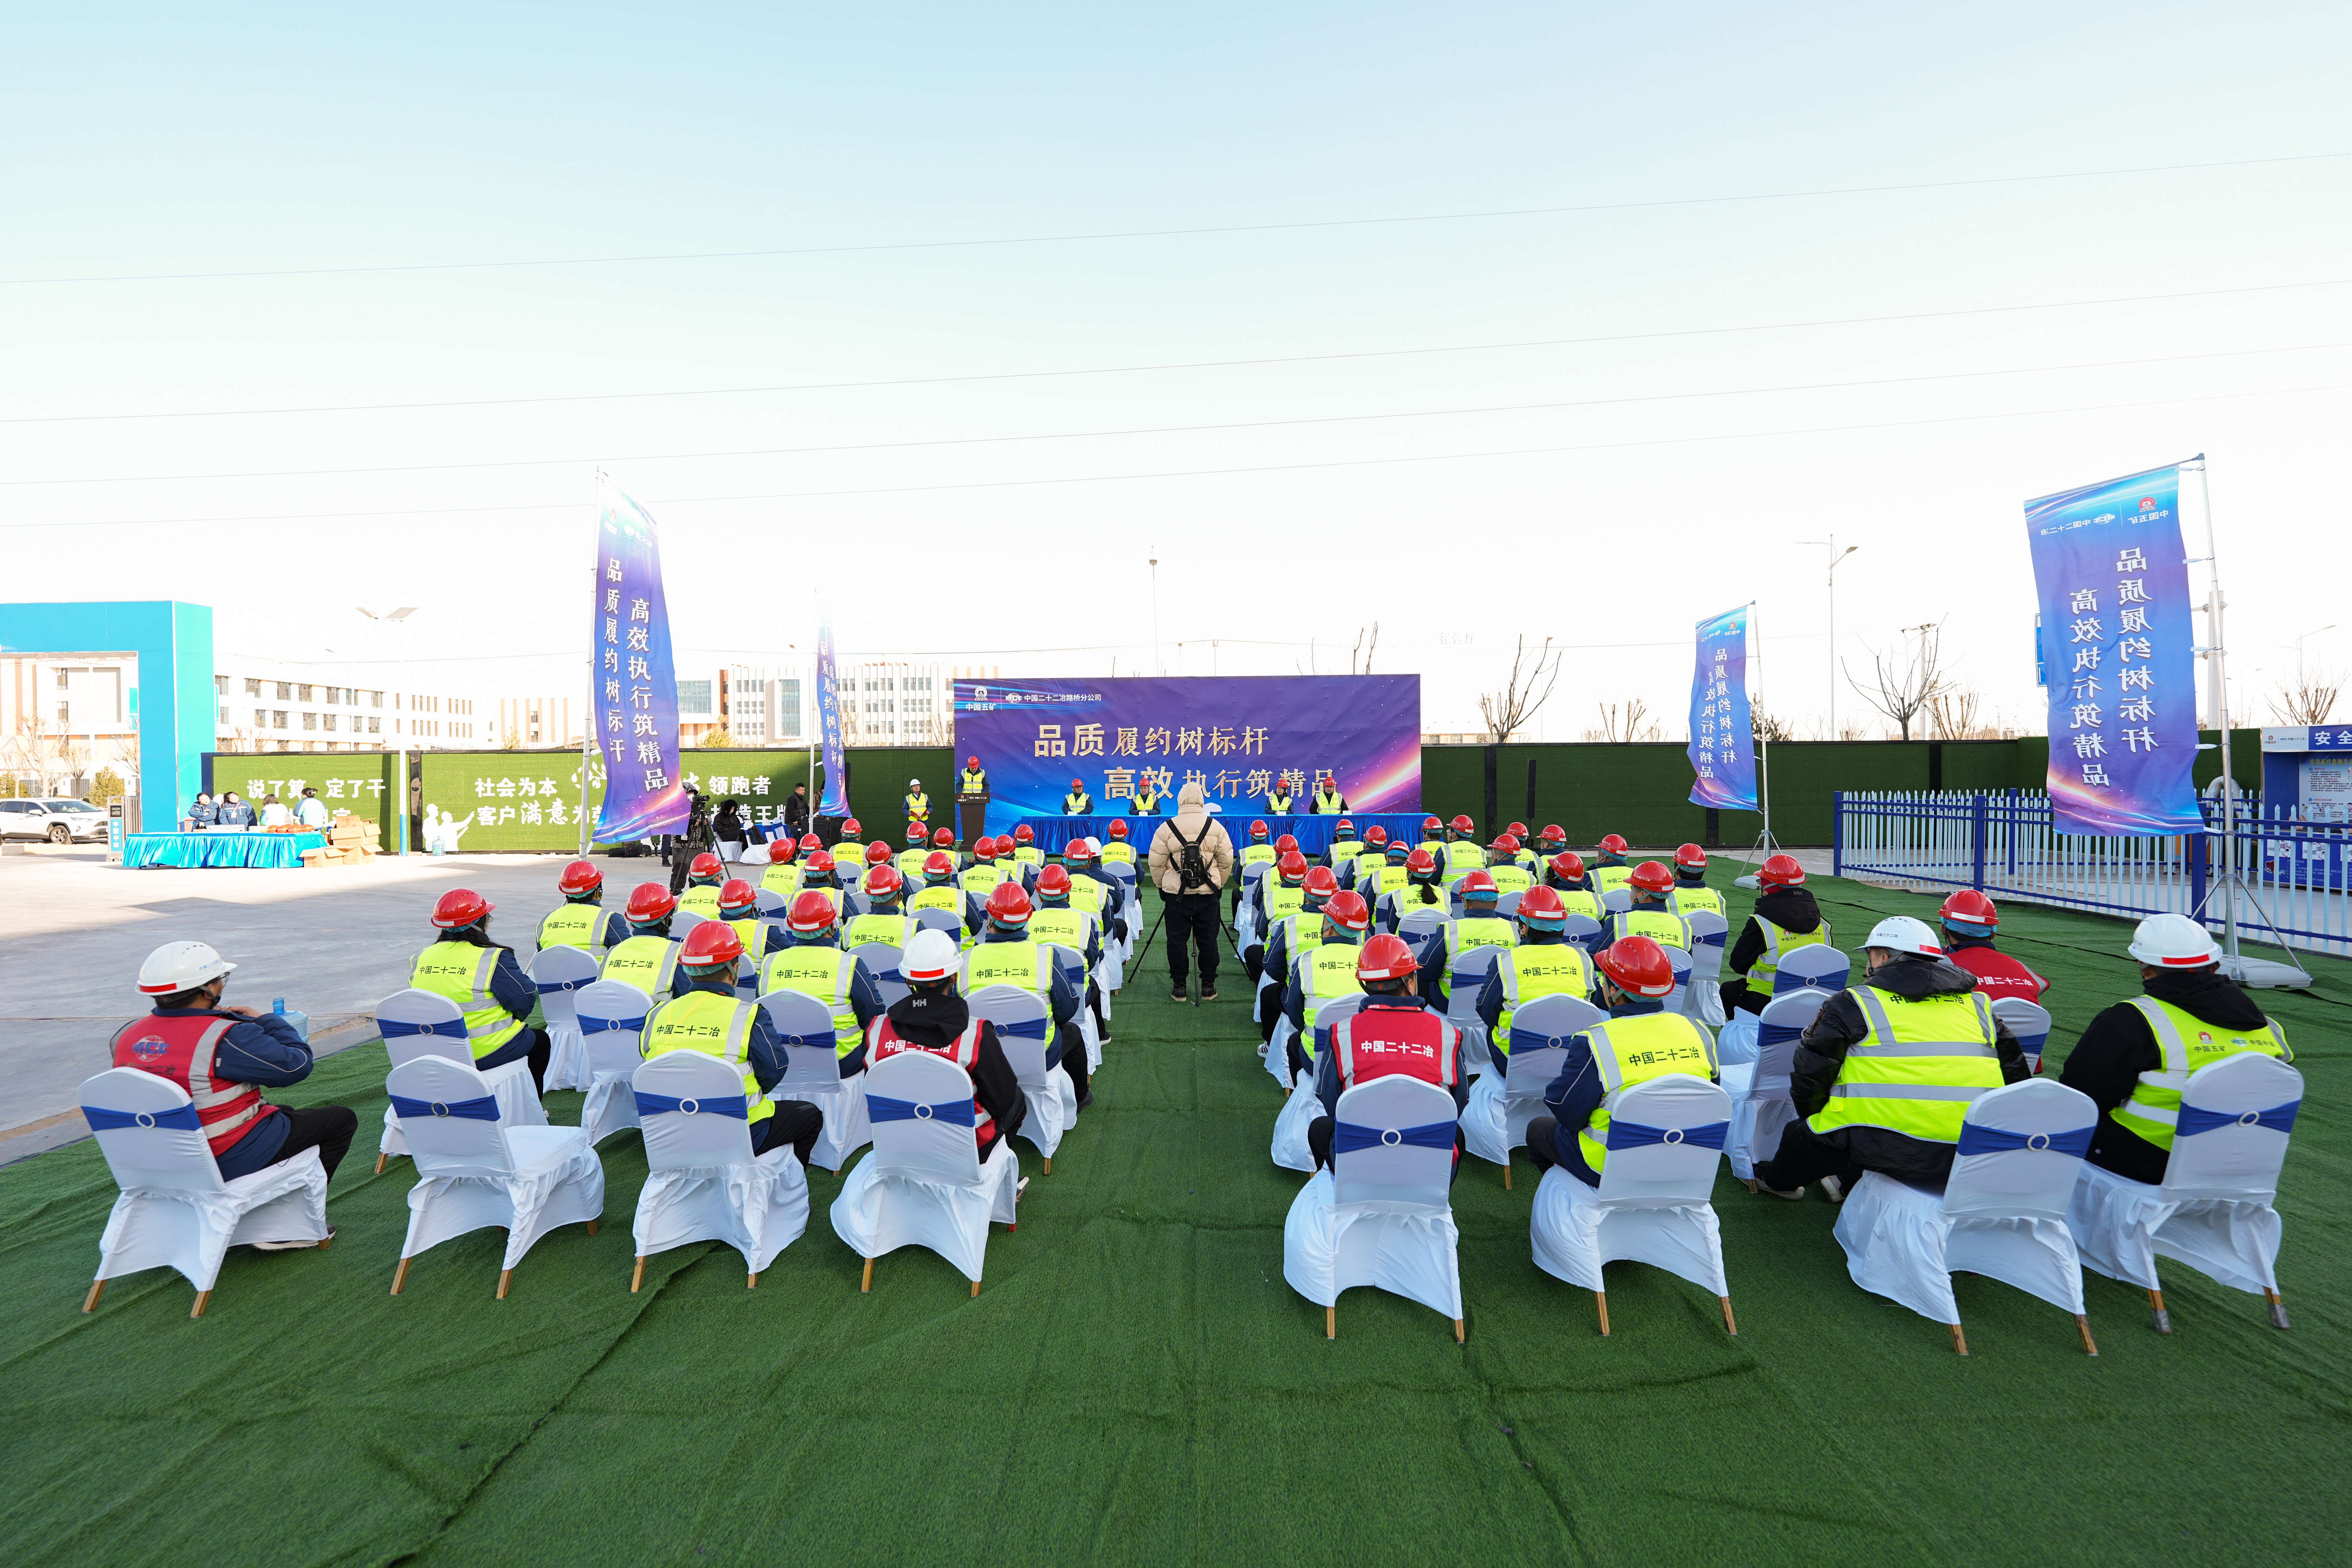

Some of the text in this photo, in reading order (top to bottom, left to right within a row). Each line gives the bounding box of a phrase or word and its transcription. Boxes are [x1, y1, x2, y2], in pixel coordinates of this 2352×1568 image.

[626, 598, 669, 792] 高效执行筑精品
[966, 703, 997, 711] 中国五矿
[326, 778, 386, 798] 定了干
[475, 777, 557, 798] 社会为本
[855, 934, 894, 943] 中国二十二冶
[1636, 930, 1678, 942] 中国二十二冶
[1466, 939, 1509, 947] 中国二十二冶
[608, 960, 654, 969] 中国二十二冶
[1319, 962, 1358, 970] 中国二十
[419, 966, 467, 975] 中国二十二冶
[776, 969, 828, 979] 中国二十二冶
[977, 968, 1029, 978] 中国二十二冶
[1522, 966, 1577, 977] 中国二十二冶
[1976, 976, 2034, 986] 中国二十二冶
[913, 998, 927, 1008] HH
[657, 1024, 720, 1037] 中国二十二冶
[133, 1041, 169, 1054] MCC
[1361, 1040, 1434, 1058] 中国二十二冶
[1629, 1047, 1700, 1066] 中国二十二冶
